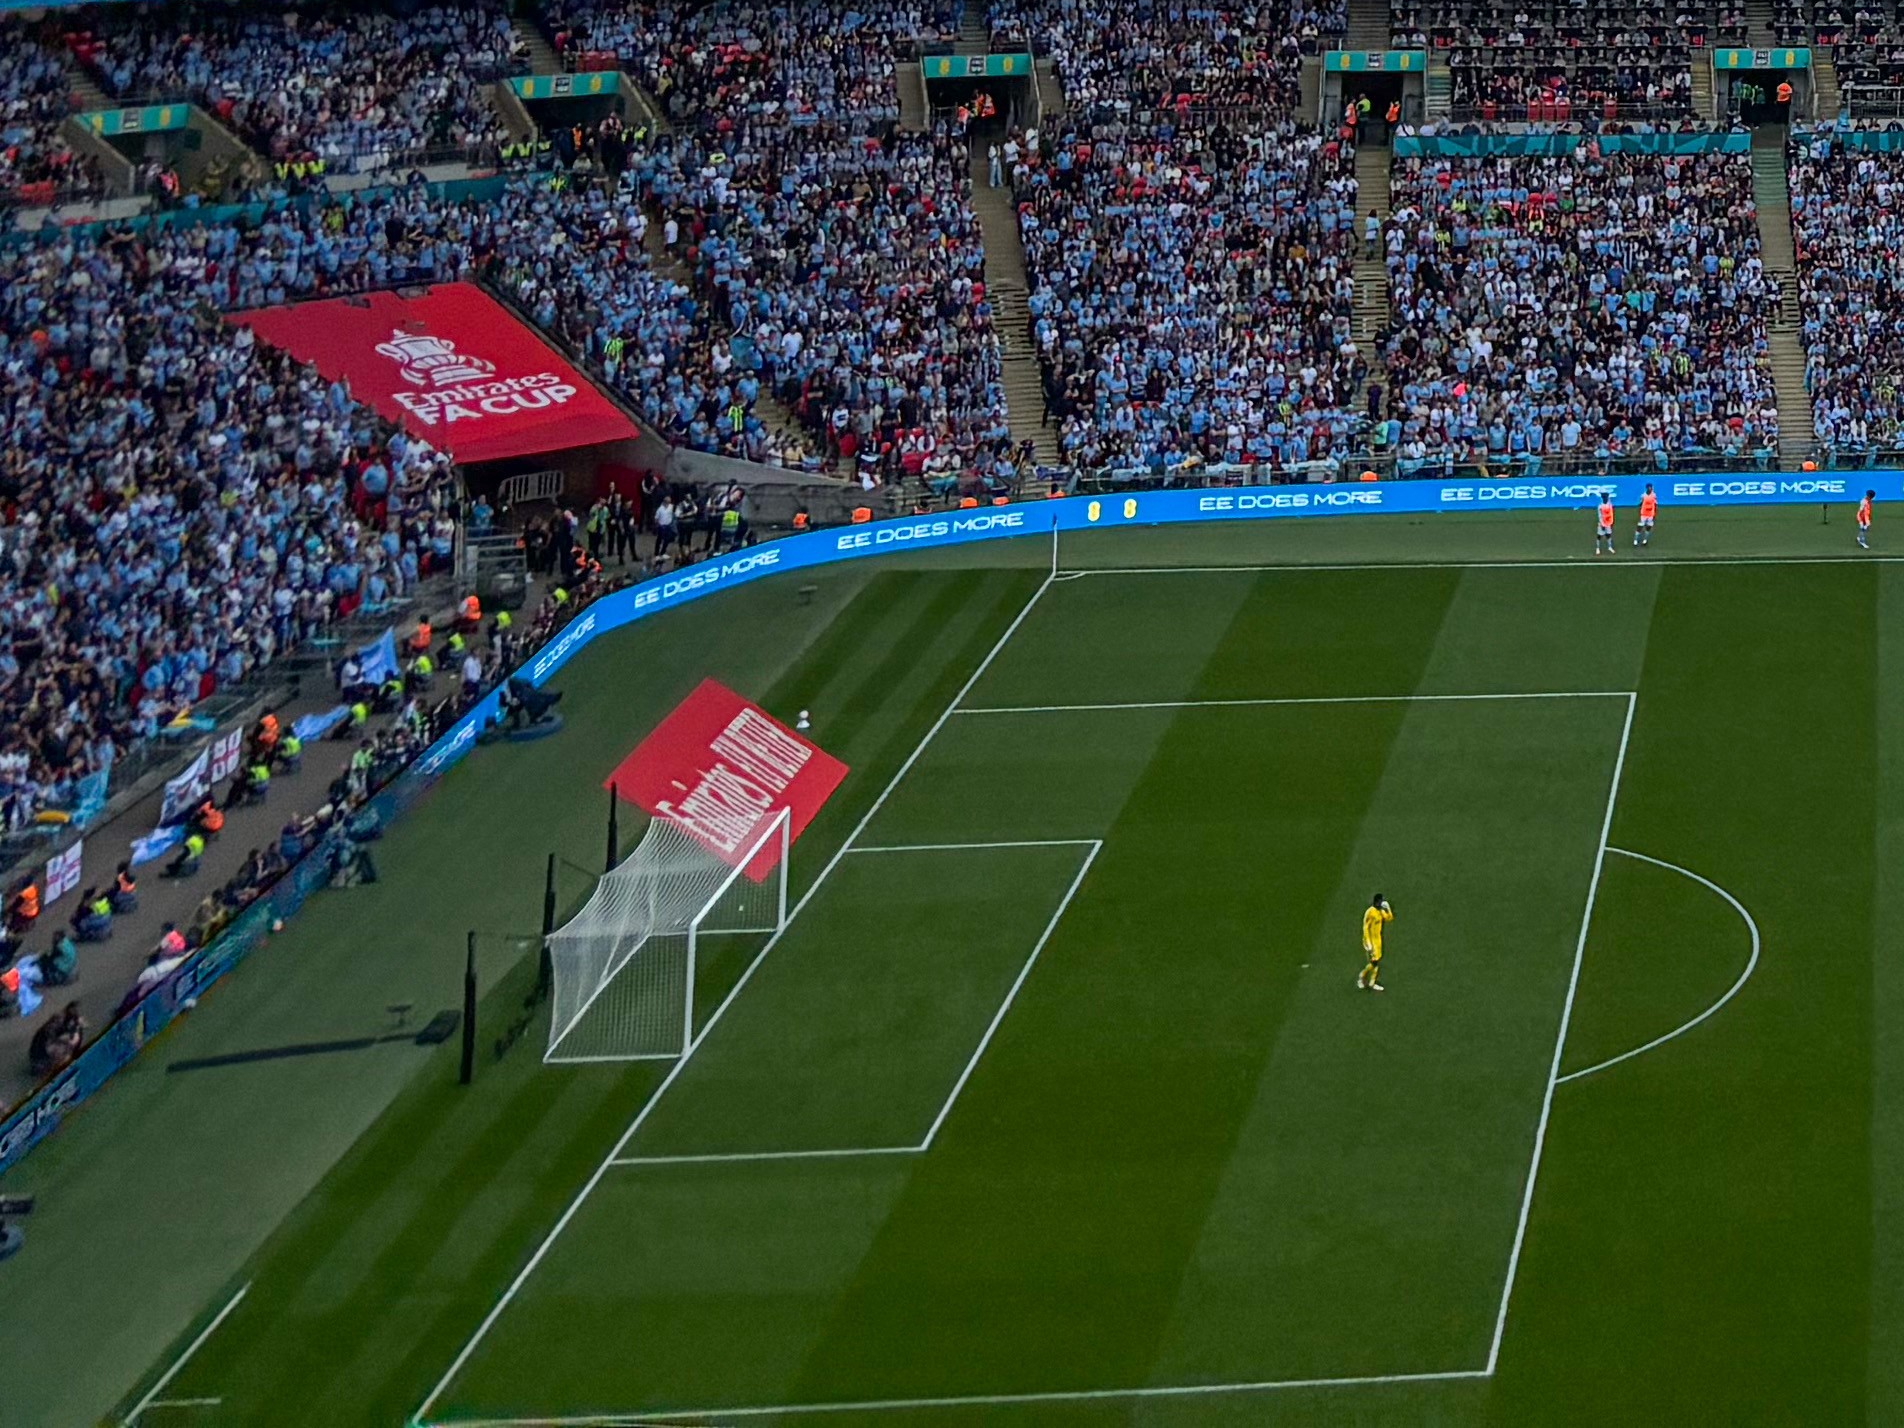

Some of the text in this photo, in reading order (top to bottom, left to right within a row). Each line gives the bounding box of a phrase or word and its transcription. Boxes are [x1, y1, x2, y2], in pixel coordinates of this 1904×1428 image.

[392, 372, 560, 410] Emirates
[413, 385, 577, 425] FA CUP
[1200, 491, 1382, 511] EE DOES MORE
[1441, 484, 1617, 501] EE DOES MORE
[1673, 480, 1845, 496] EE DOES MORE
[837, 512, 1024, 549] EE DOES MORE
[635, 548, 780, 608] EE DOES MORE
[656, 763, 774, 853] Emirates
